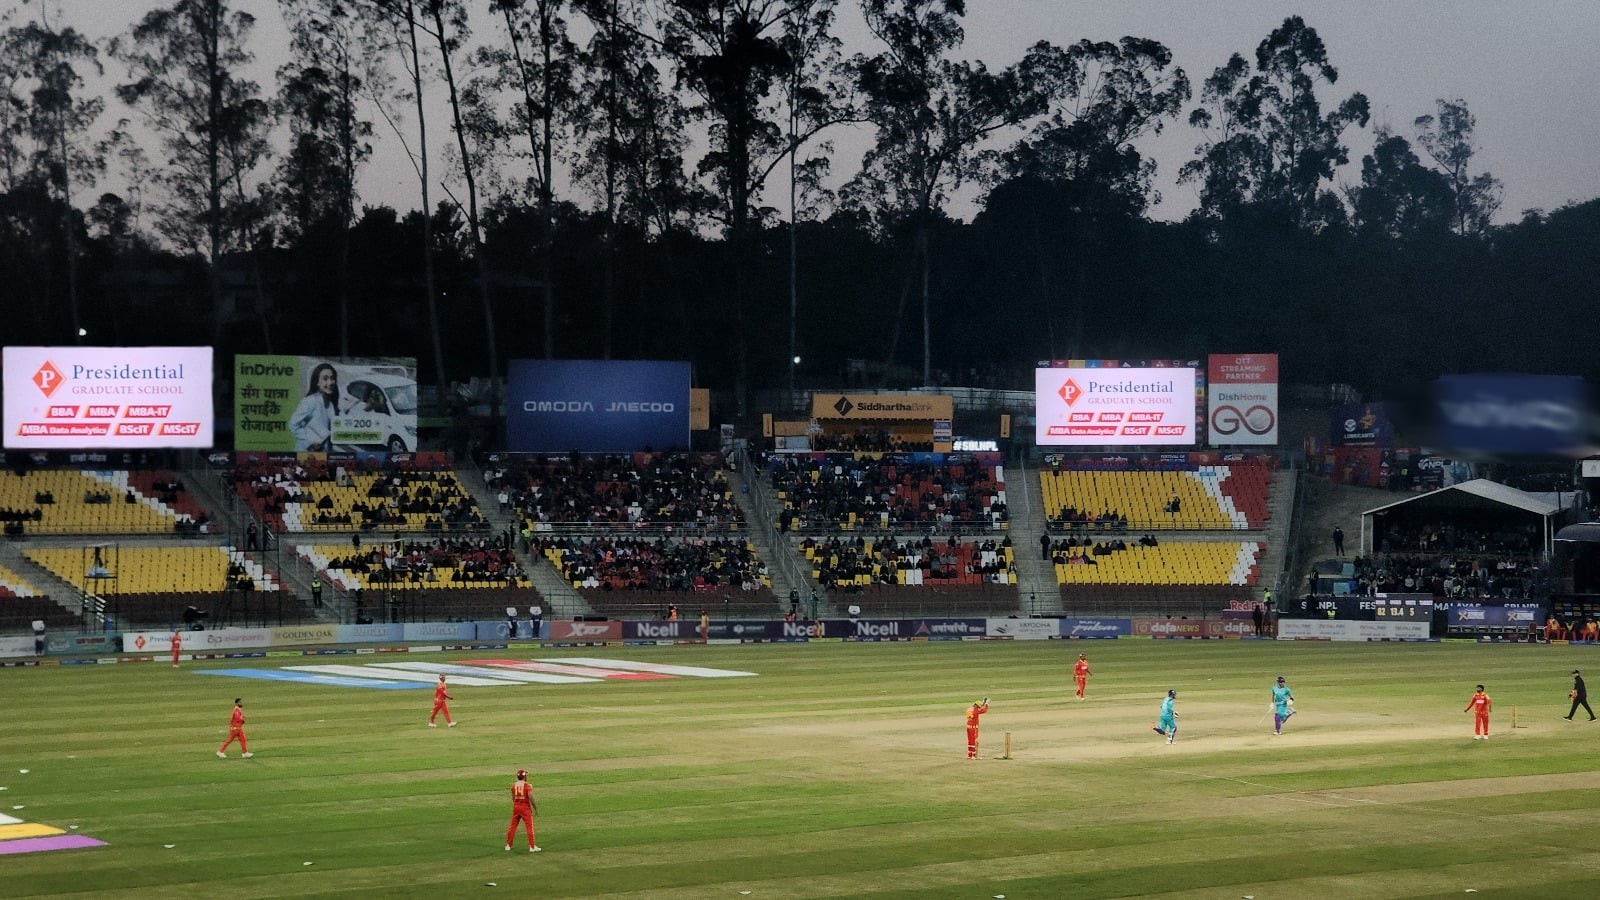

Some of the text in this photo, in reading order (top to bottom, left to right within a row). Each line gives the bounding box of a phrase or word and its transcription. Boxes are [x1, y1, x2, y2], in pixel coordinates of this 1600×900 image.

[72, 364, 184, 380] Presidential
[240, 362, 294, 376] inDrive
[72, 385, 184, 395] GRADUATE SCHOOL
[1088, 380, 1173, 393] Presidential
[264, 388, 289, 400] यात्रा
[1218, 392, 1267, 401] DishHome
[1088, 396, 1173, 405] GRADUATE SCHOOL
[51, 406, 169, 417] BBA MBA MBA-IT
[524, 401, 674, 413] OMODA JAECOO
[1072, 413, 1161, 422] BBA MBA MBA-IT
[354, 419, 372, 428] 200
[22, 424, 48, 434] MBA
[70, 426, 107, 436] Analytics
[119, 424, 149, 434] BScIT
[163, 424, 197, 434] MScIT
[1050, 427, 1070, 435] MBA
[1124, 427, 1148, 435] BScIT
[1158, 427, 1183, 435] MScIT
[1230, 600, 1249, 611] Red
[637, 623, 678, 637] Ncell
[784, 622, 825, 636] Ncel
[857, 622, 898, 636] Ncell
[282, 631, 314, 640] GOLDEN
